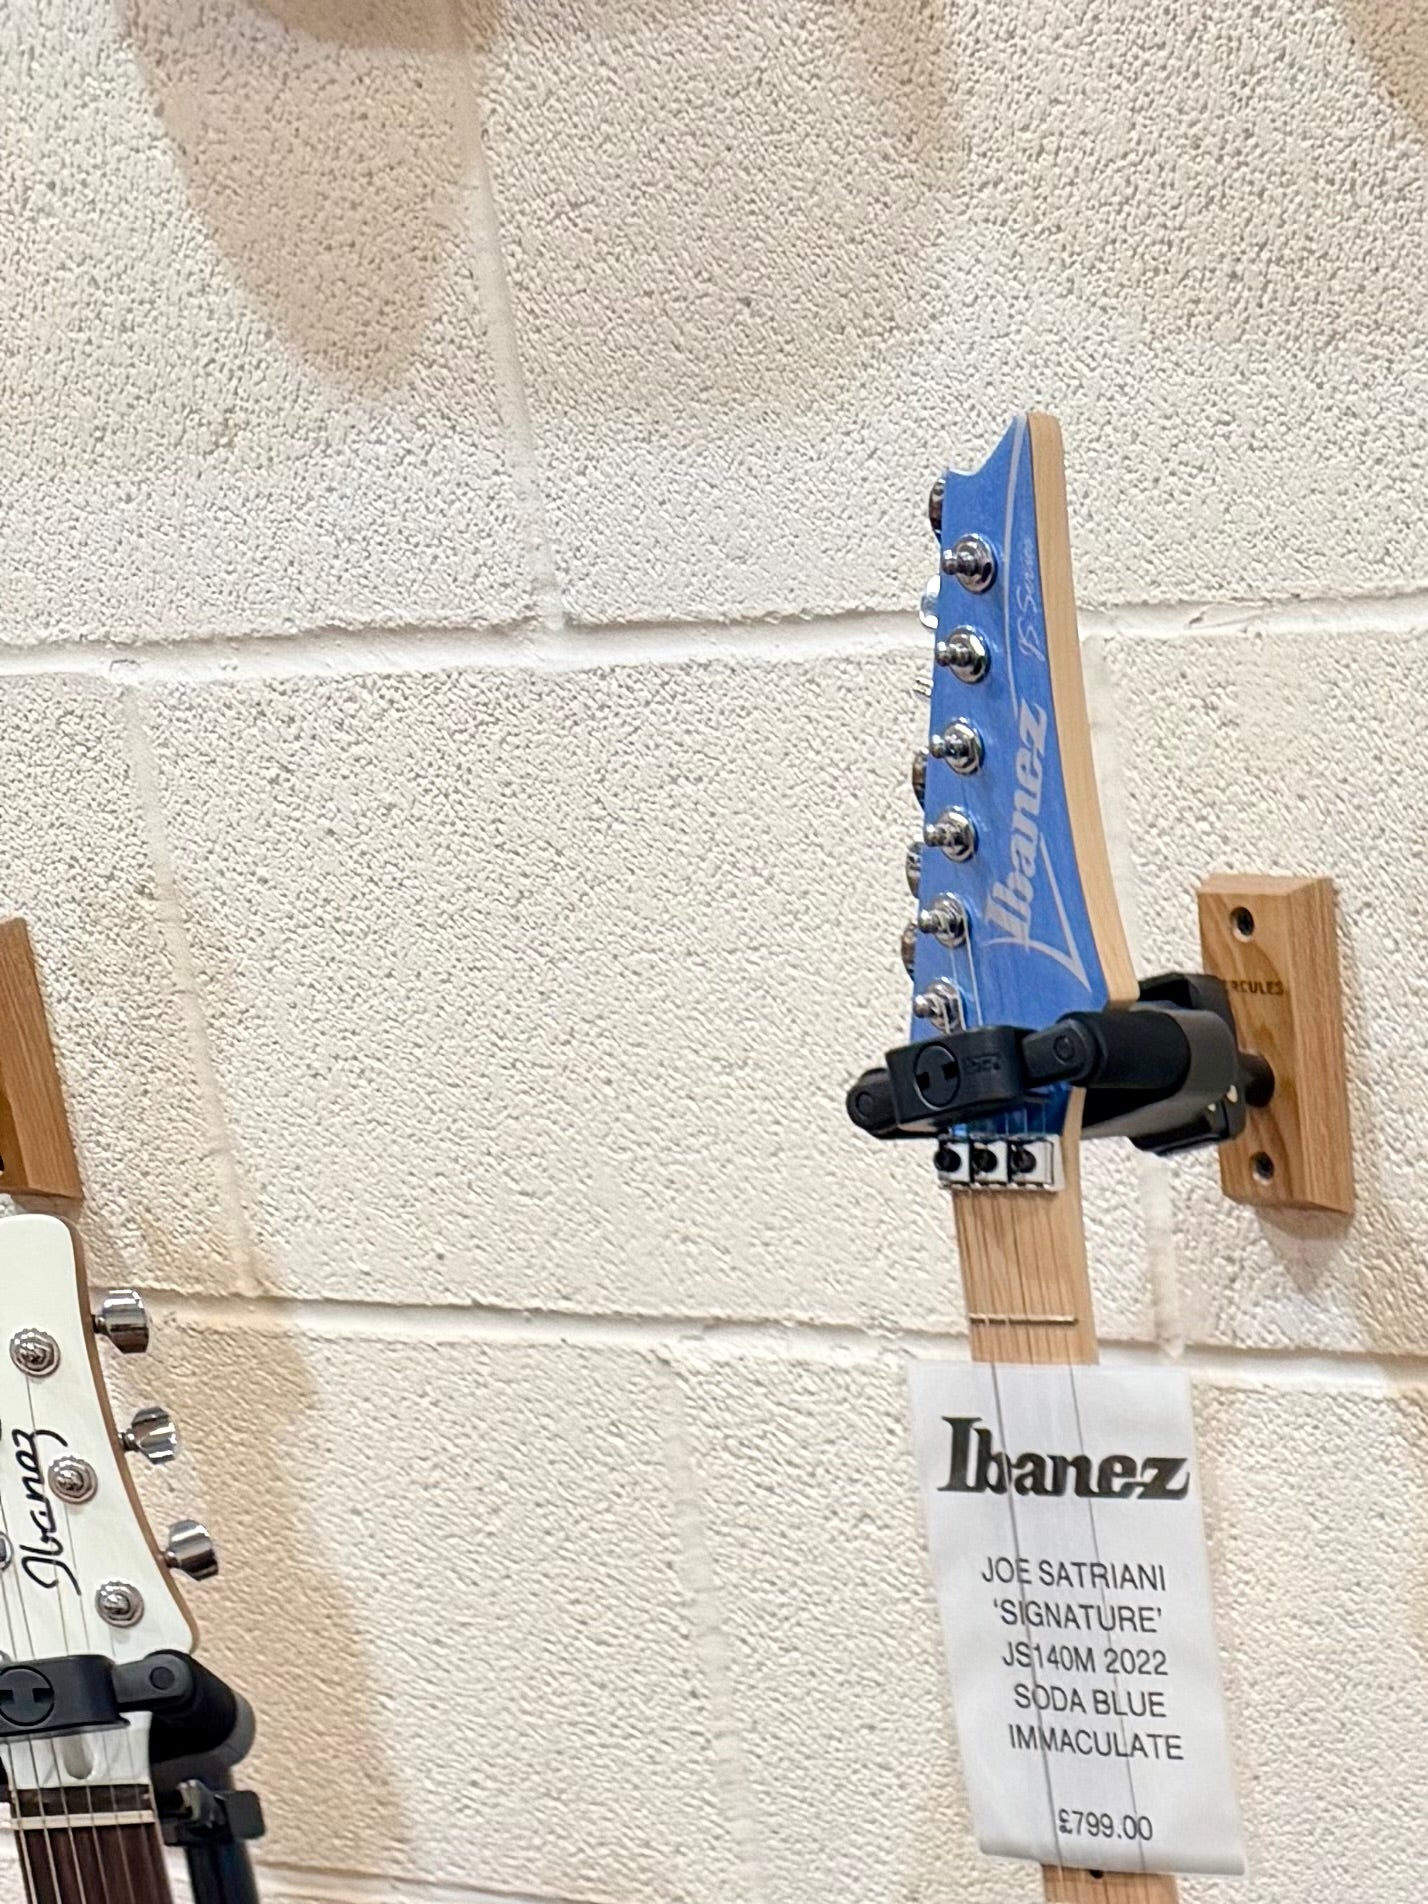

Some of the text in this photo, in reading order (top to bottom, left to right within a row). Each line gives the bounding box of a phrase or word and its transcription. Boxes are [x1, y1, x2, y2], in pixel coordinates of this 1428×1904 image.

[984, 698, 1048, 953] Ibanez
[1231, 980, 1284, 996] RCULES
[936, 1416, 1190, 1499] Ibanez
[12, 1429, 82, 1596] Ibanez
[982, 1557, 1166, 1591] JOE SATRIANI
[1003, 1641, 1168, 1676] JS140M 2022
[1014, 1684, 1166, 1718] SODA BLUE
[1009, 1724, 1184, 1760] IMMACULATE
[1059, 1809, 1153, 1841] £799.00
